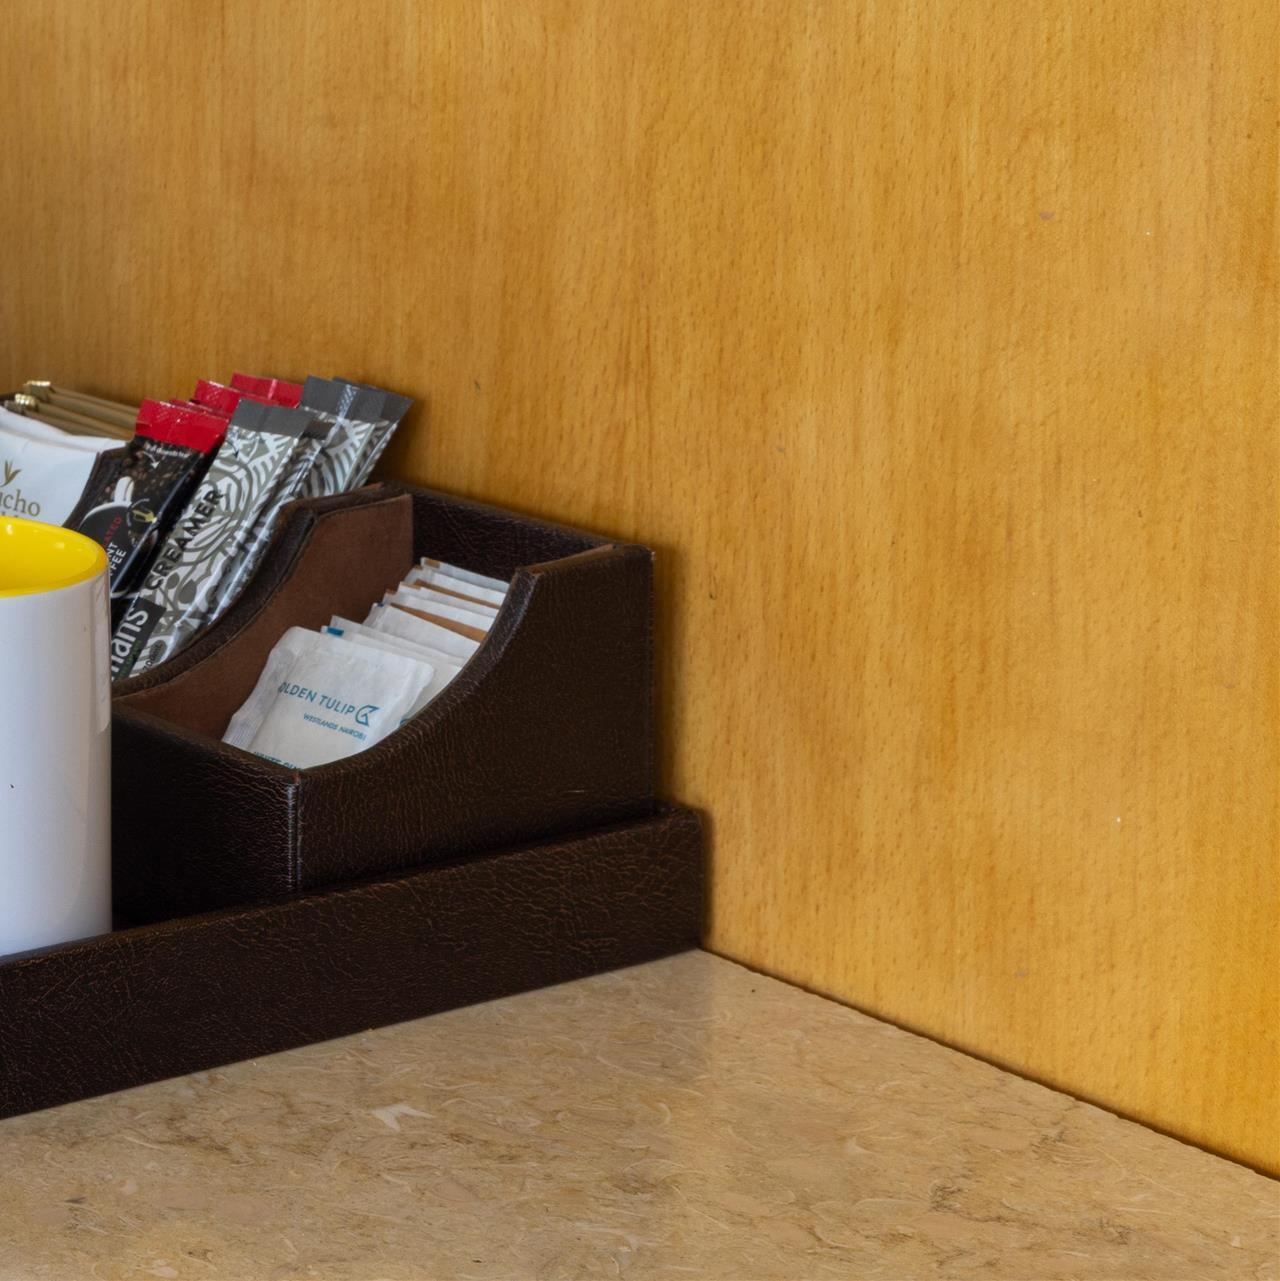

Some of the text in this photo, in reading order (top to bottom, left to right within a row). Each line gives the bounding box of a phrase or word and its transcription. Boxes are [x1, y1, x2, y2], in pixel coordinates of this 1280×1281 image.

[144, 489, 224, 591] CREAMER
[278, 681, 356, 716] OLDEN TULIP
